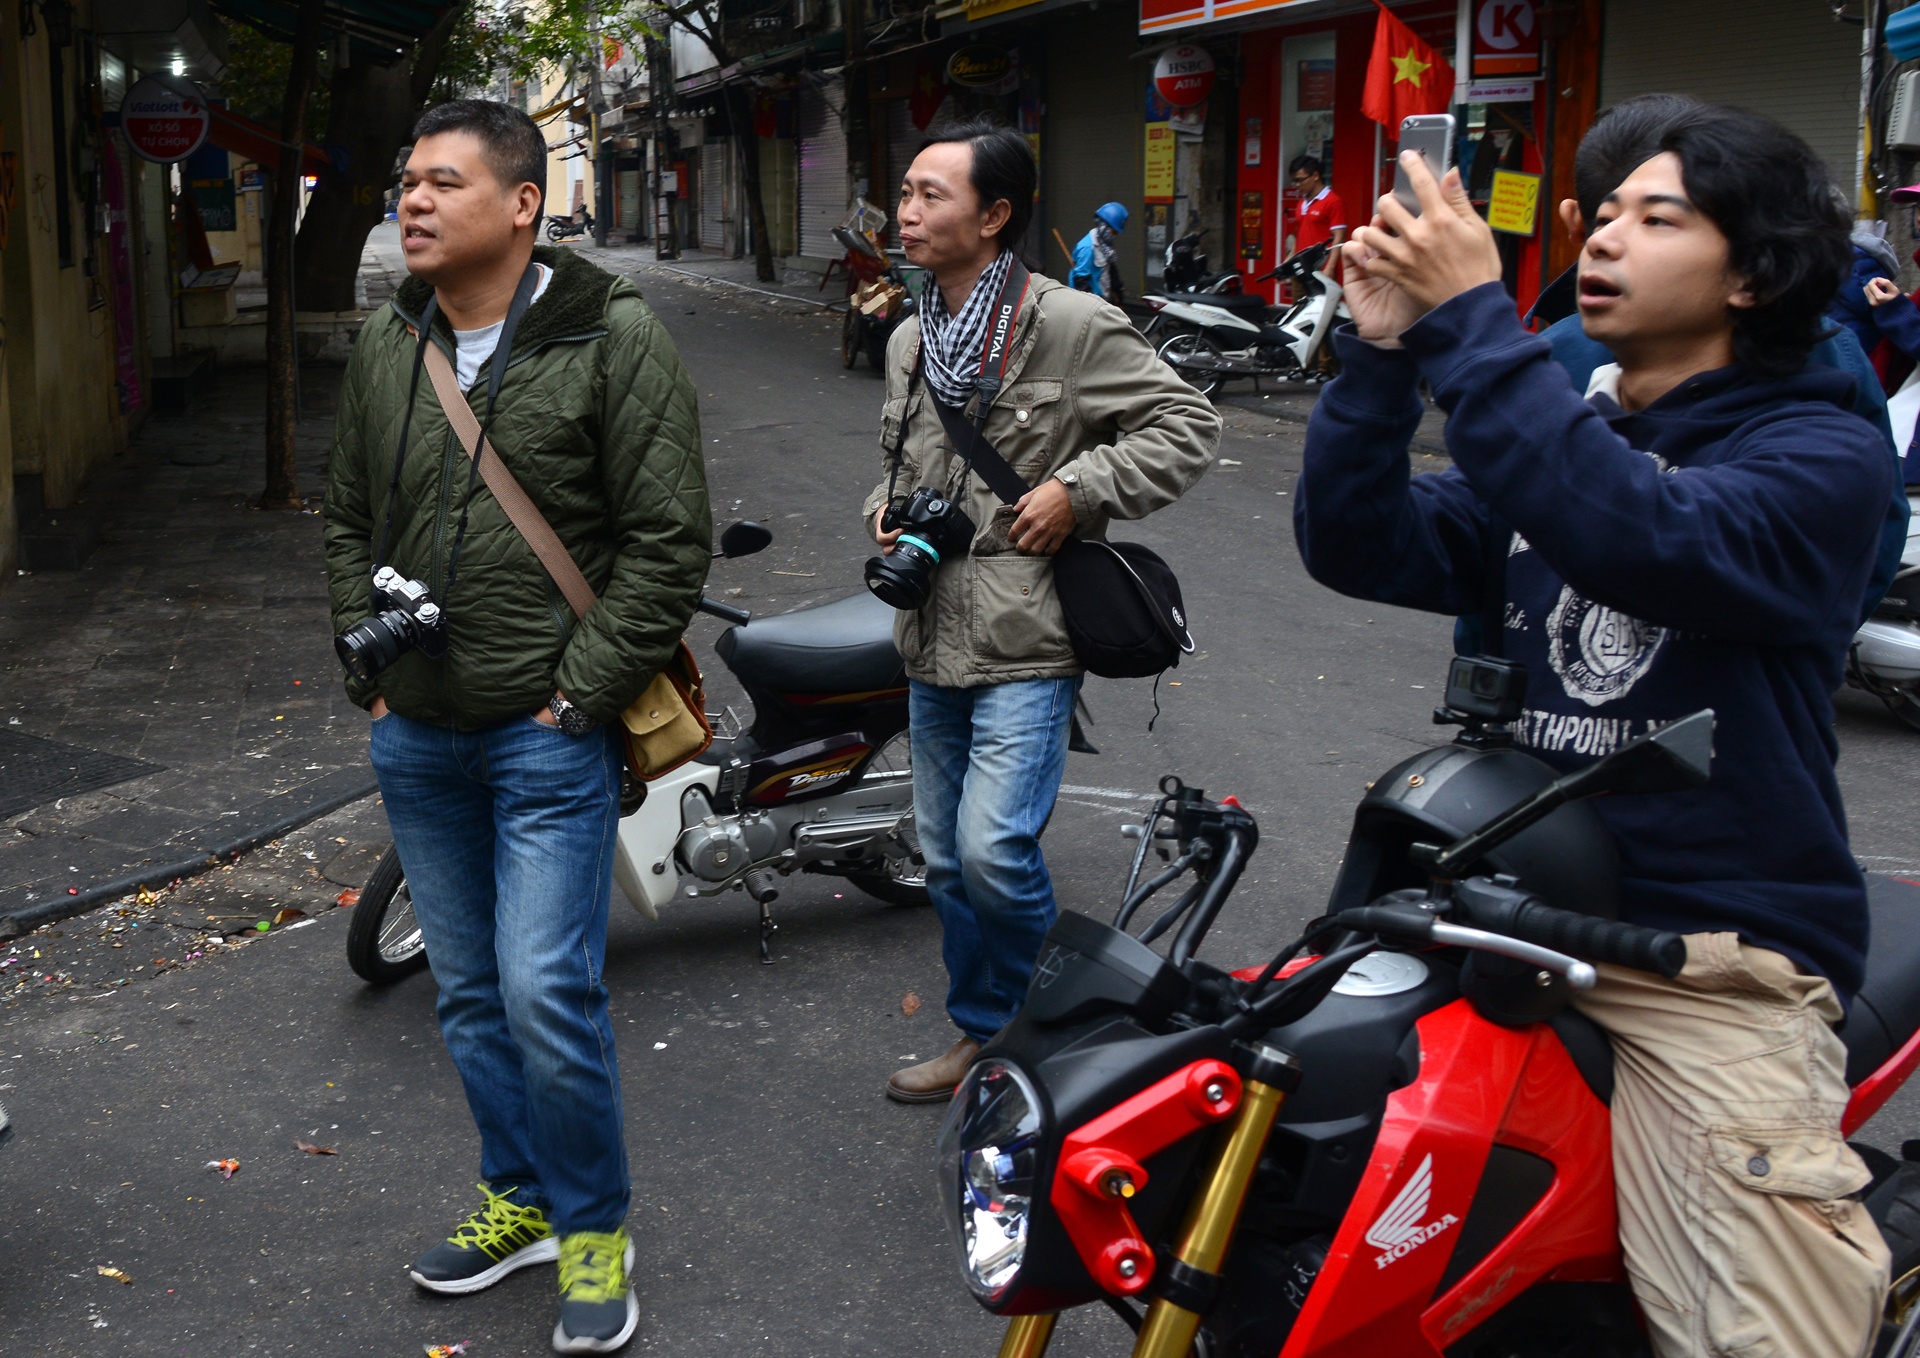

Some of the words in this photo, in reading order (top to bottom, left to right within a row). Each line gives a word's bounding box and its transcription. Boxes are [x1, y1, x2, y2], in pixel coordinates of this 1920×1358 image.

[1169, 60, 1206, 74] HSBC
[1174, 77, 1203, 91] ATM
[130, 102, 180, 113] Vietlott
[988, 304, 1013, 363] DIGITAL
[1374, 1213, 1460, 1271] HONDA
